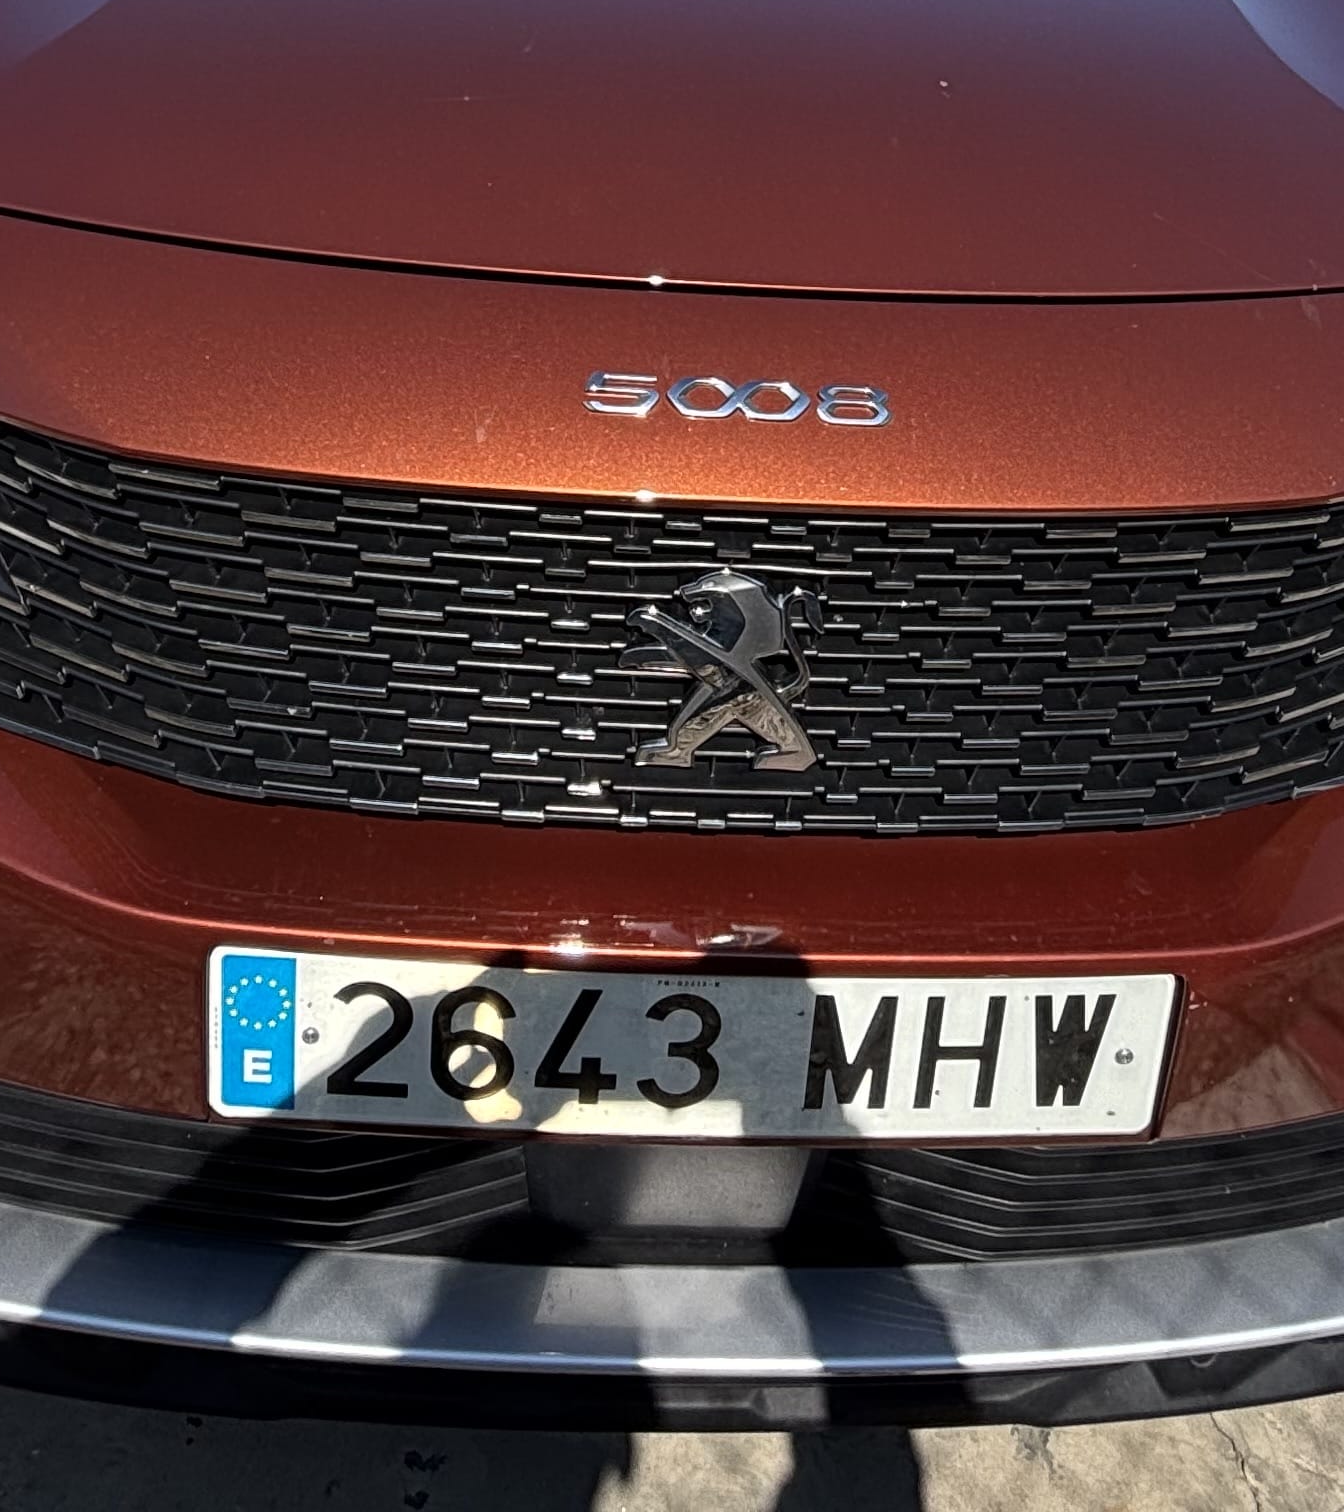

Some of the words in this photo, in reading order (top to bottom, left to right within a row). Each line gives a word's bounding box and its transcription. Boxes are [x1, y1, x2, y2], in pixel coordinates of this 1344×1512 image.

[582, 371, 893, 426] 5008
[243, 1048, 272, 1084] E
[326, 980, 724, 1110] 2643
[802, 992, 1116, 1111] MHW
